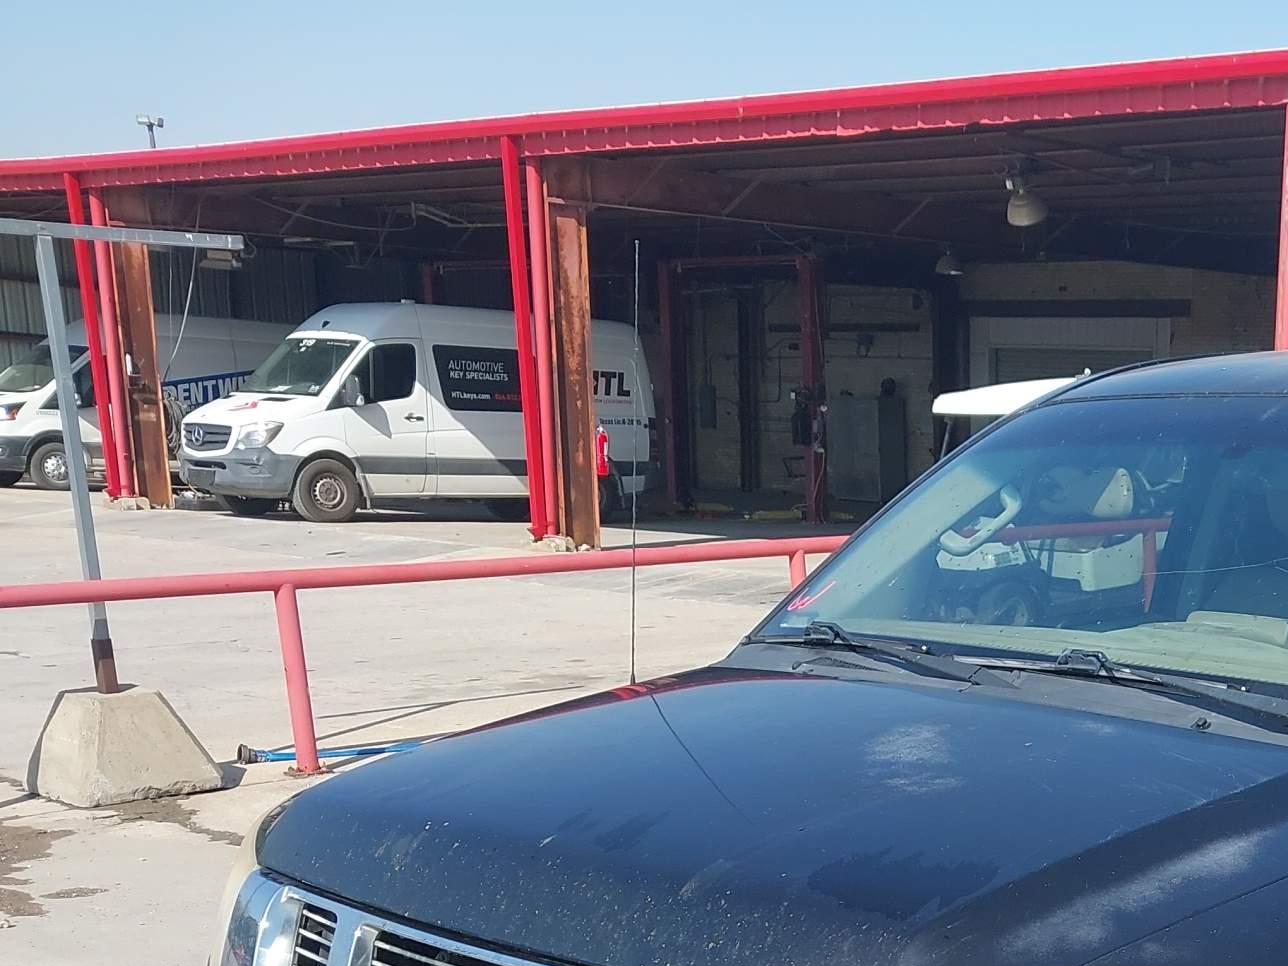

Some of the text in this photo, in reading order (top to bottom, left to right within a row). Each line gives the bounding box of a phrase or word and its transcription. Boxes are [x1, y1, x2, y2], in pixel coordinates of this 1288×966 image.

[448, 360, 504, 373] AUTOMOTIVE
[449, 371, 509, 381] KEY SPECIALISTS
